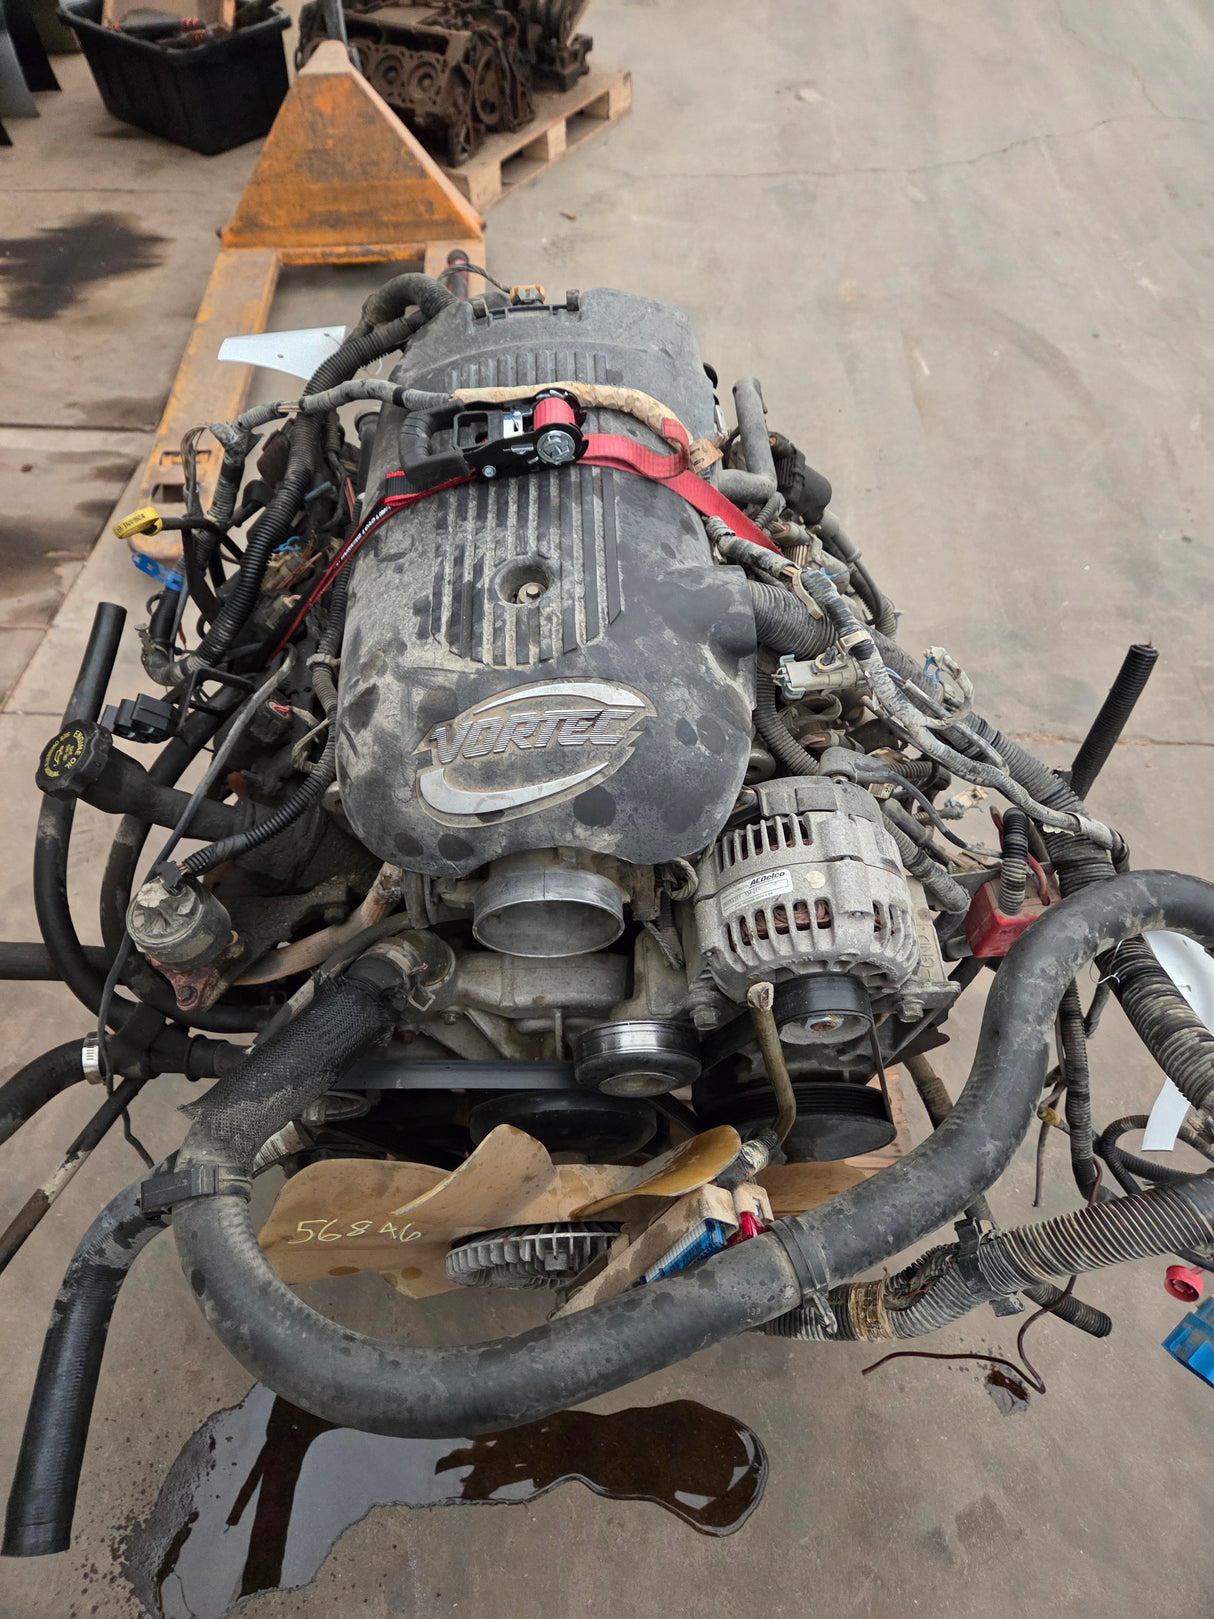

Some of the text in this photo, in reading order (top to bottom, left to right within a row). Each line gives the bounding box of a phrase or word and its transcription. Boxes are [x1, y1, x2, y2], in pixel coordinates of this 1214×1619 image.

[430, 709, 636, 764] VORTEC
[64, 757, 77, 769] OIL
[749, 871, 785, 886] ACDelco
